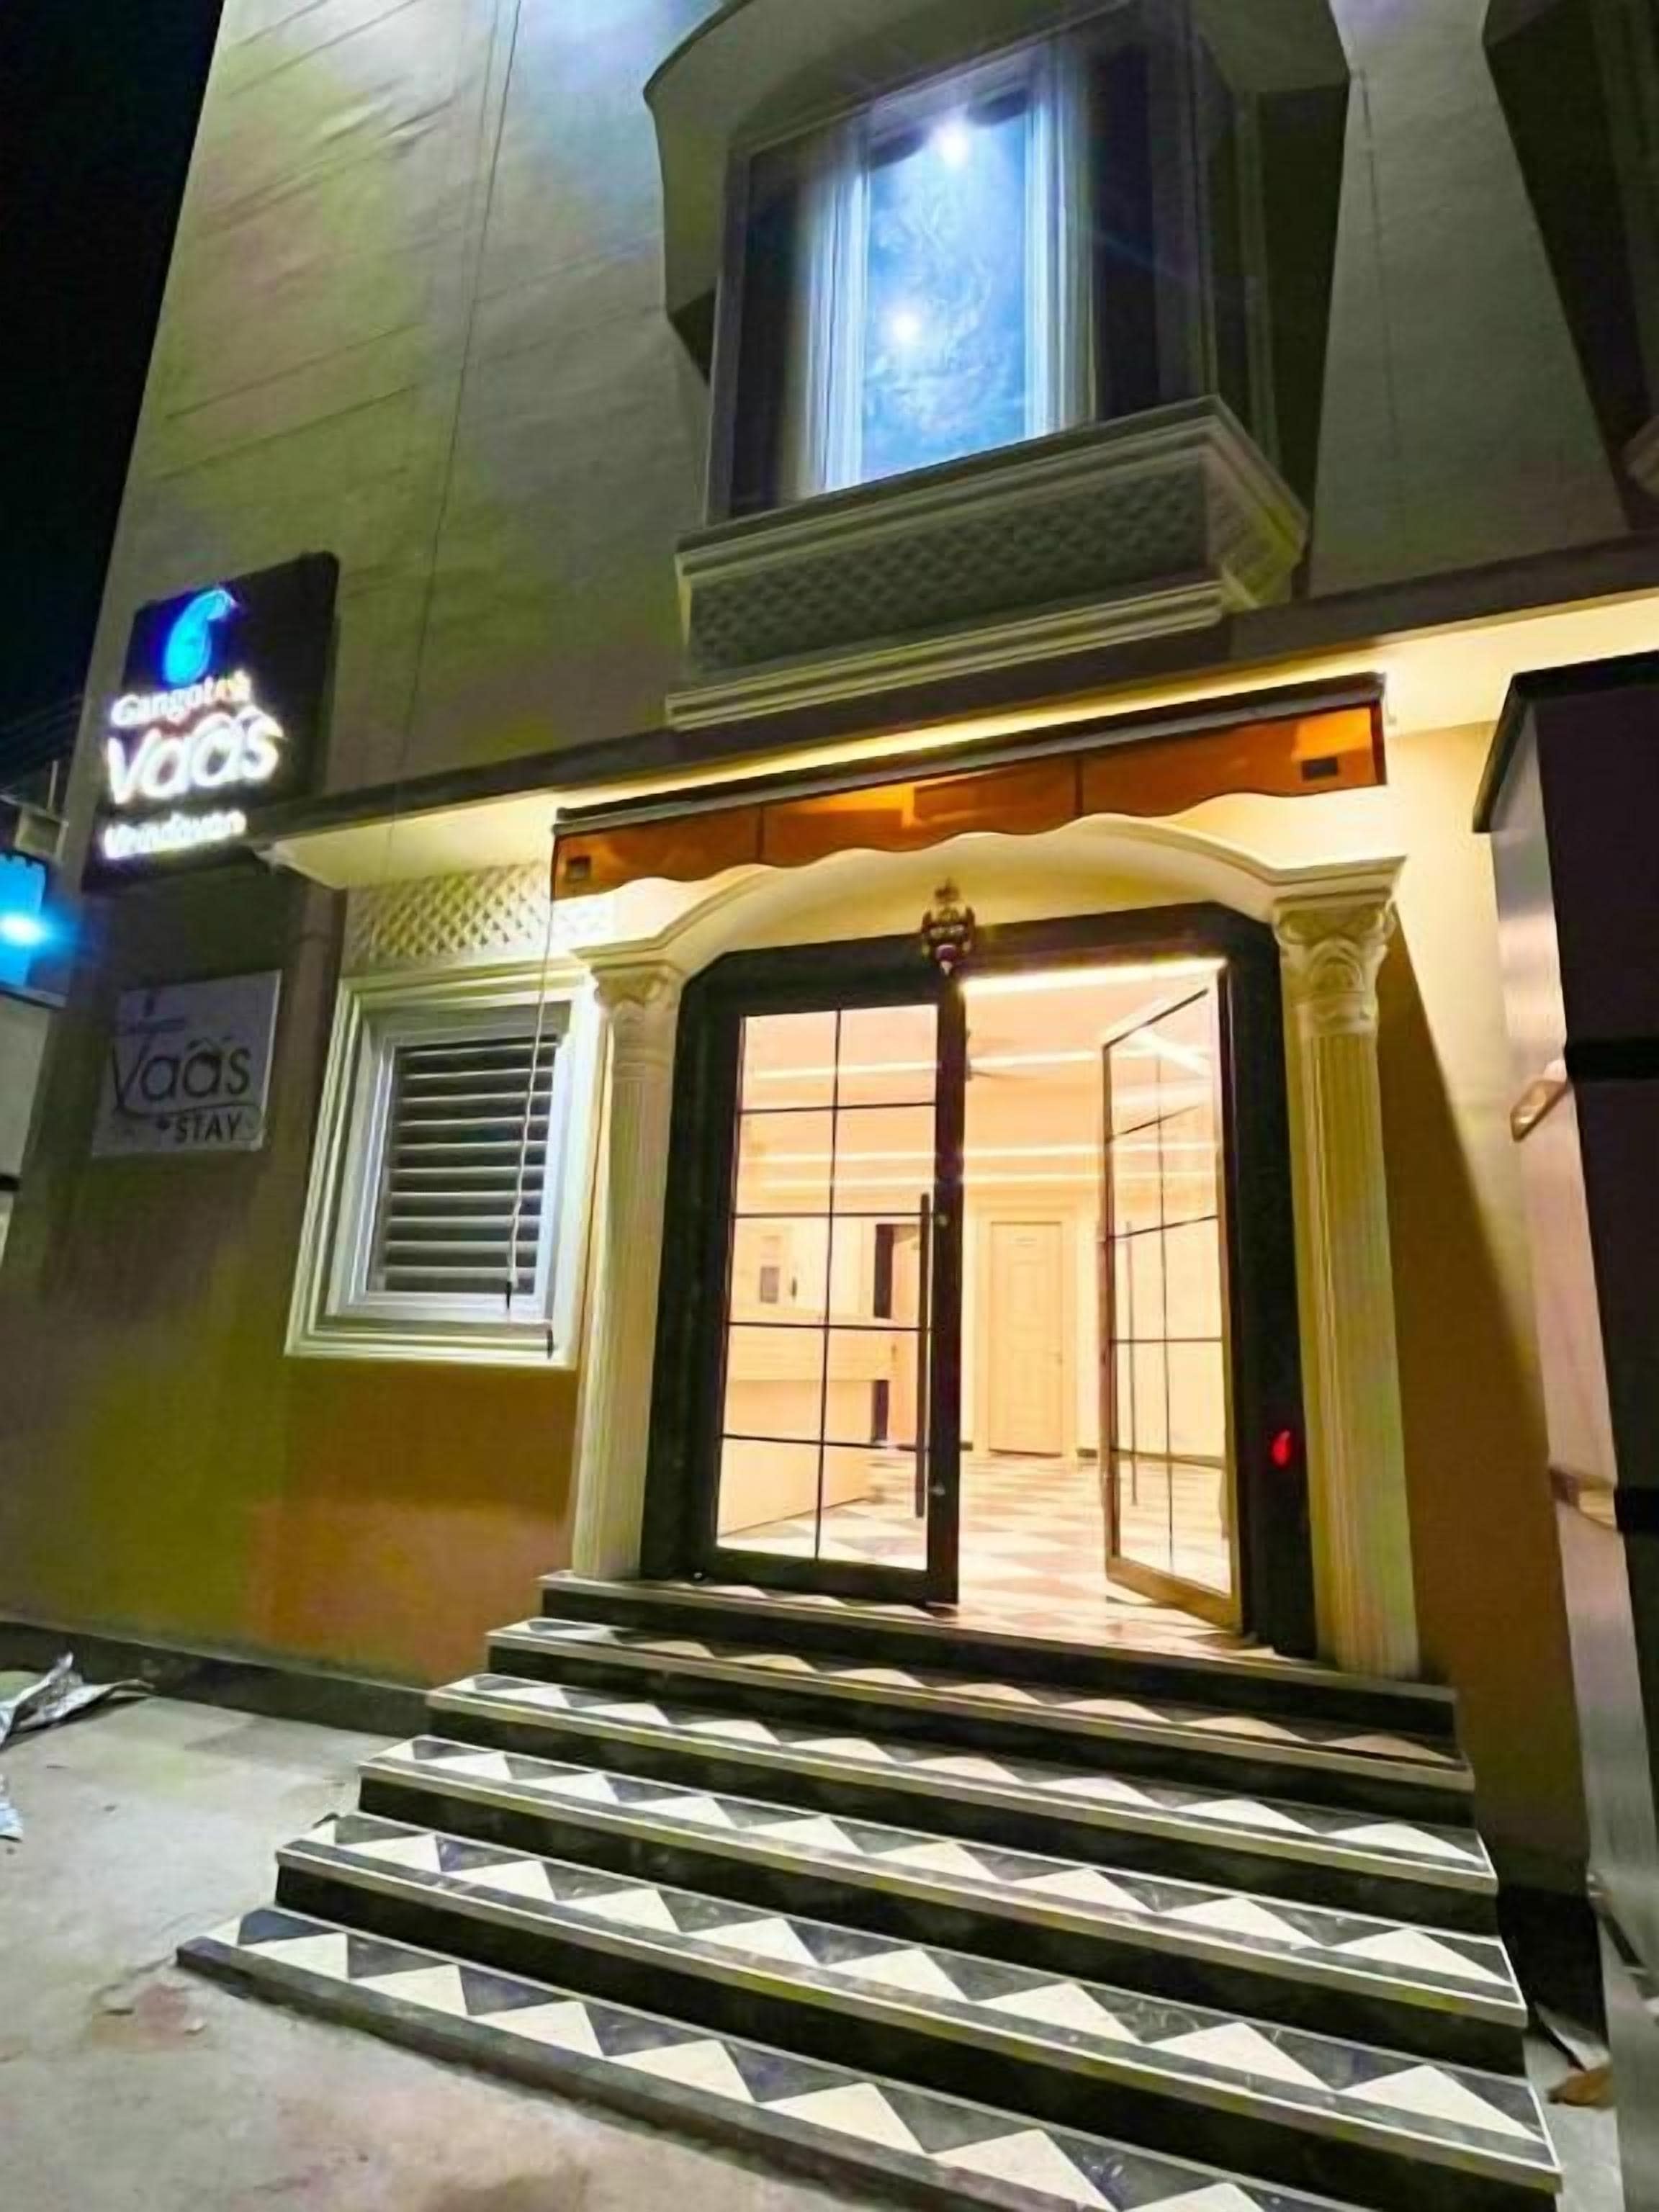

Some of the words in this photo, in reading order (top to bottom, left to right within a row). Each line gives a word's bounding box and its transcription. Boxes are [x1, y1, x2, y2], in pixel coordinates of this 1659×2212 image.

[107, 706, 284, 805] Vaas
[111, 1037, 252, 1113] Vaas
[174, 1112, 242, 1143] STAY
